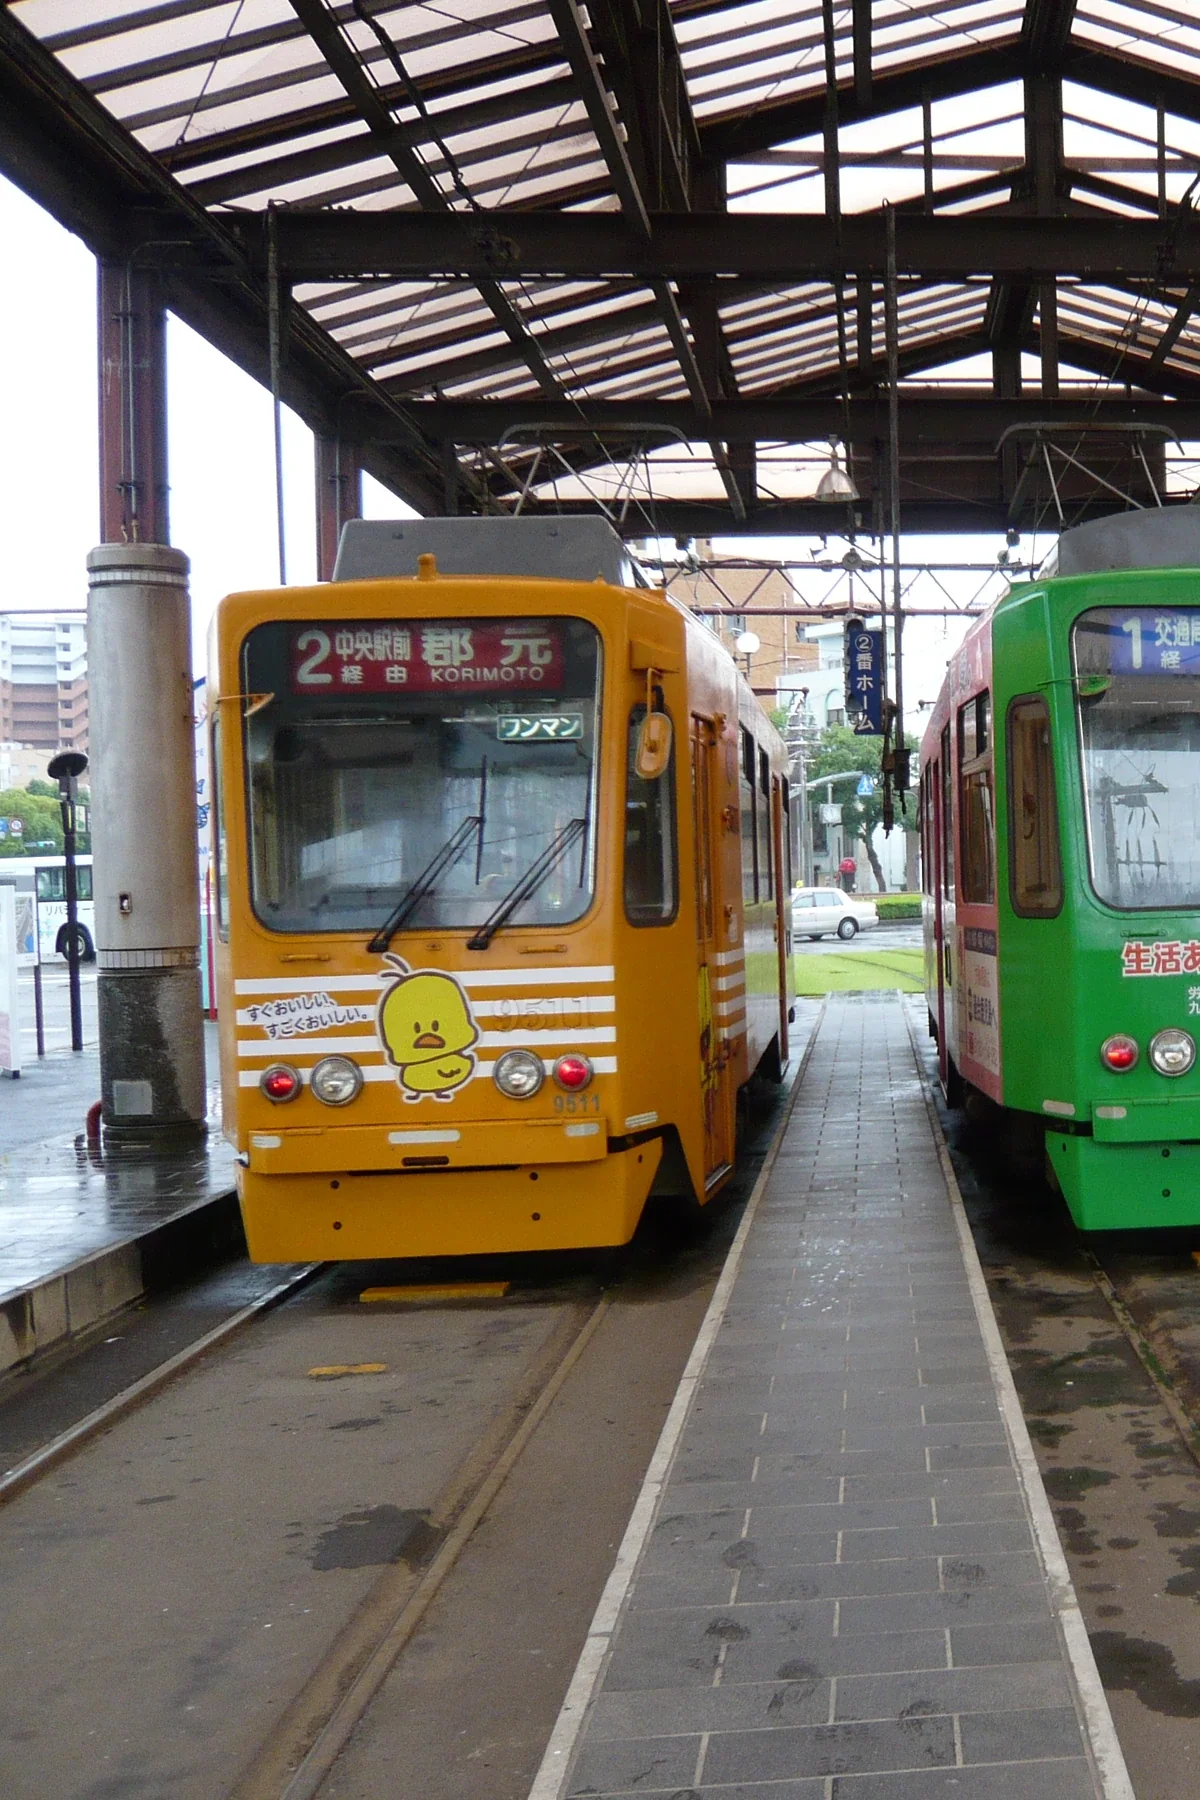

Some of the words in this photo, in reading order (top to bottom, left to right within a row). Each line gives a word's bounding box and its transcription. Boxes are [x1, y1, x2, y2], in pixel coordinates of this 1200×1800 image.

[297, 630, 332, 684] 2
[335, 630, 411, 661] 中央駅前
[422, 628, 552, 666] 郡元
[1122, 618, 1142, 669] 1
[341, 665, 408, 684] 経由
[431, 667, 544, 682] KORIMOTO
[501, 717, 580, 737] ワンマン
[247, 994, 335, 1021] すぐおいしい、
[266, 1008, 367, 1038] すごくおいしい。
[554, 1093, 601, 1113] 9511
